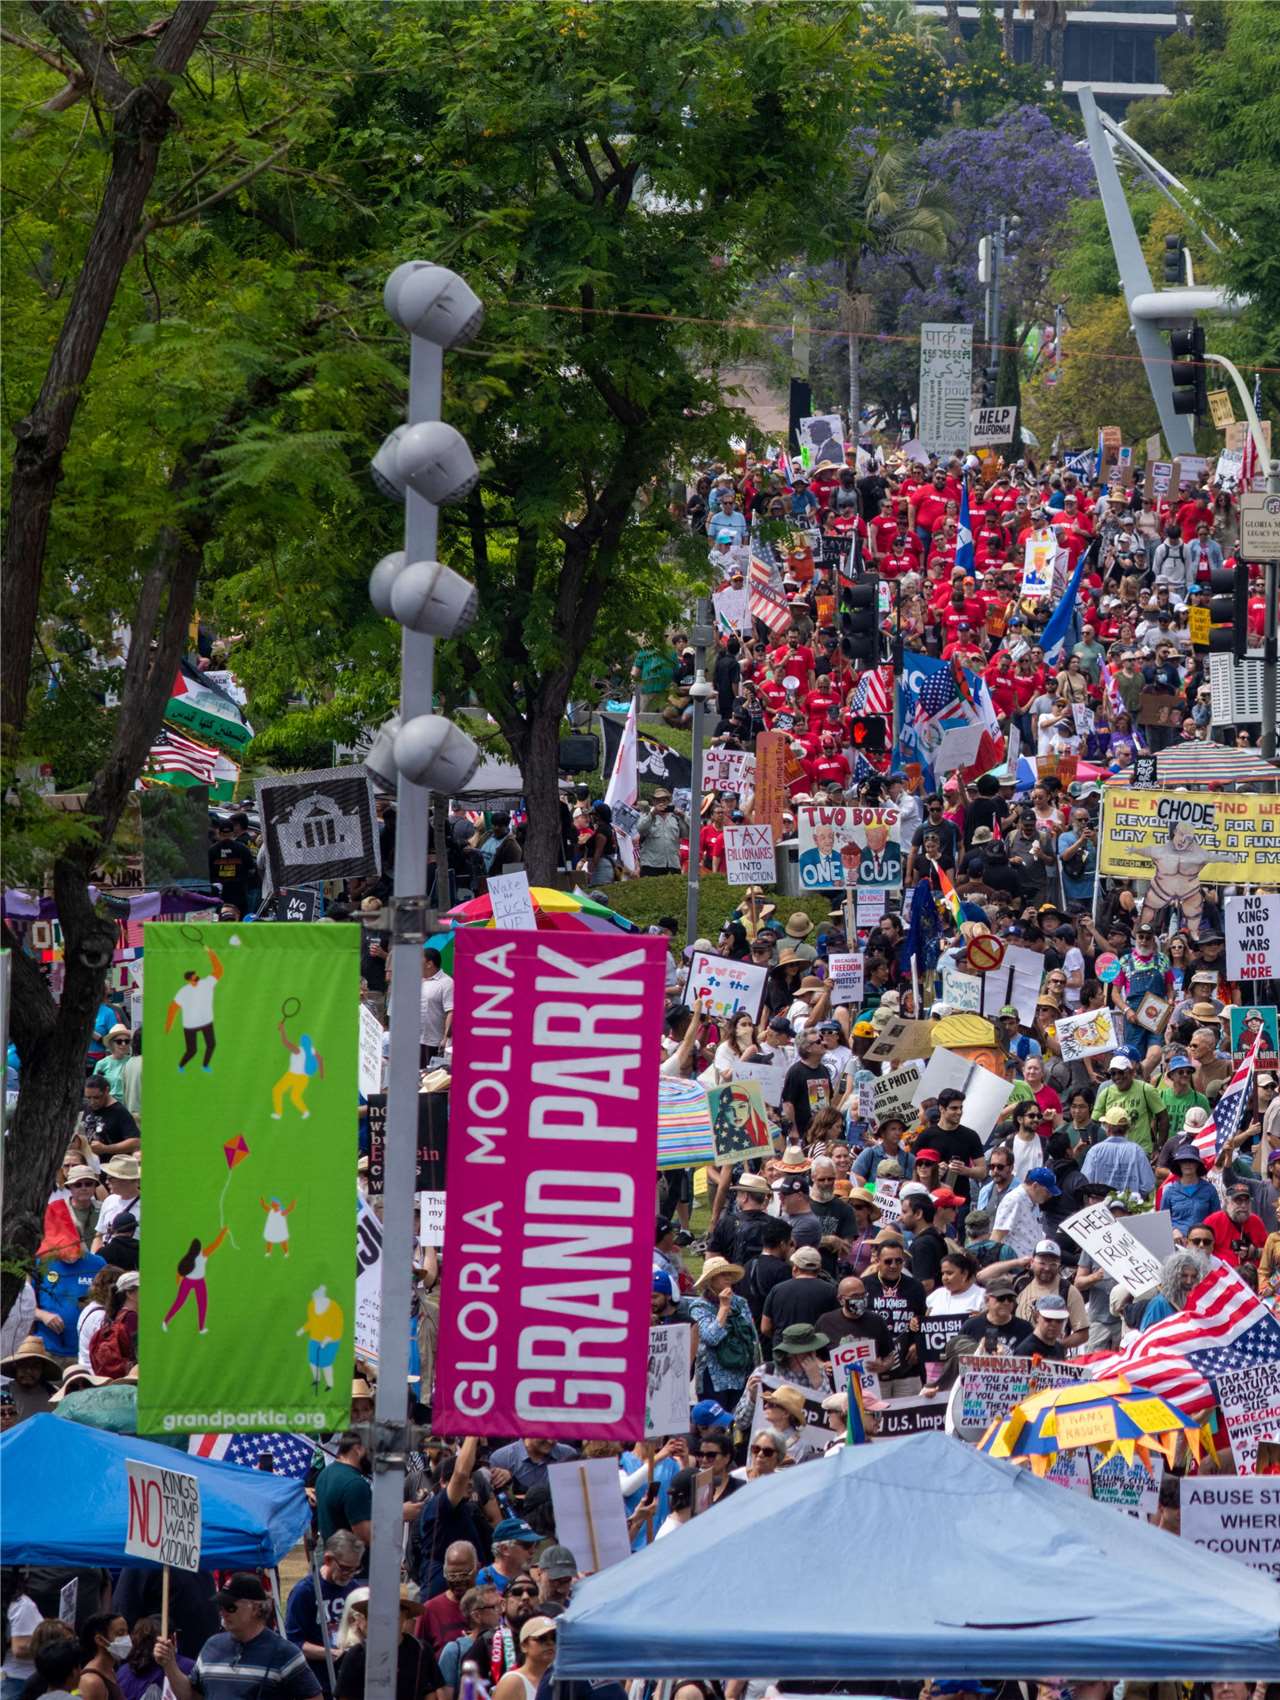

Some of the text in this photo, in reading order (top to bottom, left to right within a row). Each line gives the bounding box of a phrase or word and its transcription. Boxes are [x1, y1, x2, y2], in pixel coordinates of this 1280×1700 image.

[980, 409, 1010, 423] HELP
[974, 424, 1011, 436] CALIFORNIA
[1245, 521, 1272, 529] GLORIA
[1112, 797, 1139, 810] WE
[802, 807, 899, 826] TWO BOYS
[1158, 799, 1216, 825] CHODE
[1225, 819, 1256, 832] FOR
[1262, 820, 1274, 832] A
[727, 827, 769, 846] TAX
[1111, 829, 1146, 841] WAY
[1227, 834, 1239, 847] A
[728, 847, 773, 860] BILLIONAIRES
[739, 861, 762, 870] INTO
[729, 871, 773, 882] EXTINCTION
[802, 860, 899, 887] ONE CUP
[1244, 897, 1262, 910] NO
[1237, 908, 1269, 922] KINGS
[1246, 924, 1264, 937] NO
[1239, 938, 1270, 952] WARS
[1246, 952, 1266, 965] NO
[1240, 965, 1272, 979] MORE
[729, 979, 750, 992] the
[529, 944, 646, 1143] PARK
[466, 942, 516, 1165] MOLINA
[888, 1069, 919, 1089] PHOTO
[429, 1209, 443, 1217] my
[1102, 1230, 1112, 1244] OF
[515, 1171, 635, 1424] GRAND
[874, 1297, 907, 1308] NO KINGS
[454, 1201, 503, 1418] GLORIA
[893, 1310, 915, 1320] WAR
[920, 1320, 962, 1332] ABOLISH
[834, 1345, 871, 1364] ICE
[1054, 1364, 1084, 1377] THEY
[1217, 1364, 1278, 1387] TARJETAS
[981, 1375, 999, 1383] YOU
[976, 1392, 994, 1400] YOU
[1223, 1385, 1280, 1408] CONOZCA
[963, 1400, 1008, 1409] RUN THEN
[1242, 1398, 1270, 1413] SUS
[164, 1411, 325, 1429] grandparkla.org
[963, 1409, 985, 1417] WALK
[887, 1415, 912, 1431] U.S.
[161, 1470, 198, 1501] KINGS
[1189, 1490, 1255, 1505] ABUSE
[129, 1475, 162, 1548] NO
[163, 1497, 199, 1524] TRUMP
[164, 1520, 196, 1542] WAR
[158, 1540, 198, 1568] KIDDING
